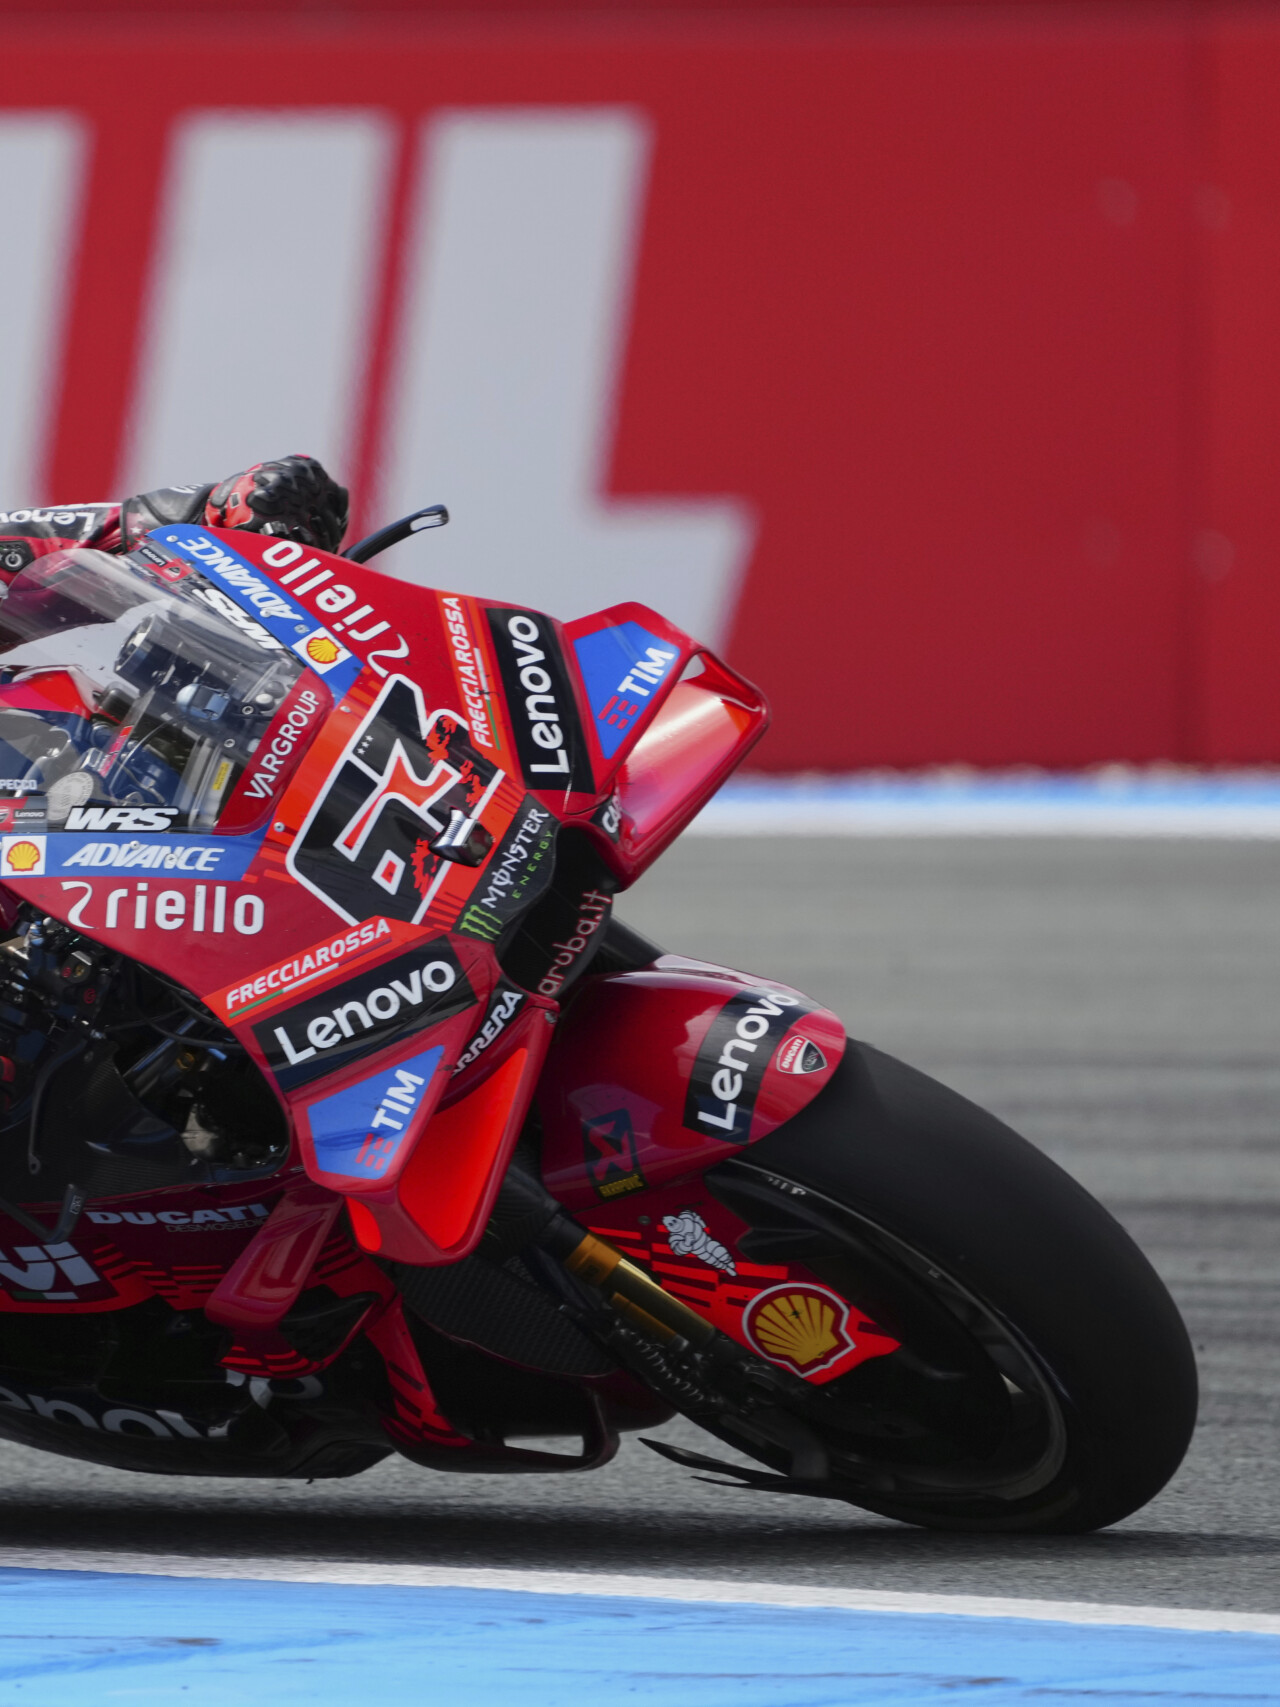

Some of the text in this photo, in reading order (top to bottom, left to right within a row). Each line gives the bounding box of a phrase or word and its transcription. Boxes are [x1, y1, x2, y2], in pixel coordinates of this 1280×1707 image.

[176, 536, 304, 621] ADVANCE
[191, 588, 285, 650] WRS
[441, 597, 493, 749] FRECCIAROSSA
[507, 615, 571, 775] Lenovo
[617, 646, 676, 697] TIM
[243, 690, 320, 799] VARGROUP
[62, 842, 225, 871] ADVANCE
[64, 807, 179, 831] WRS
[480, 808, 550, 909] MONSTER
[226, 918, 392, 1010] FRECCIAROSSA
[537, 889, 613, 996] aruba.it
[273, 960, 456, 1066] Lenovo
[451, 989, 524, 1078] RRERA
[370, 1069, 425, 1131] TIM
[697, 991, 801, 1131] Lenovo
[85, 1203, 271, 1226] DUCATI
[165, 1217, 269, 1233] DESMOSEDIC
